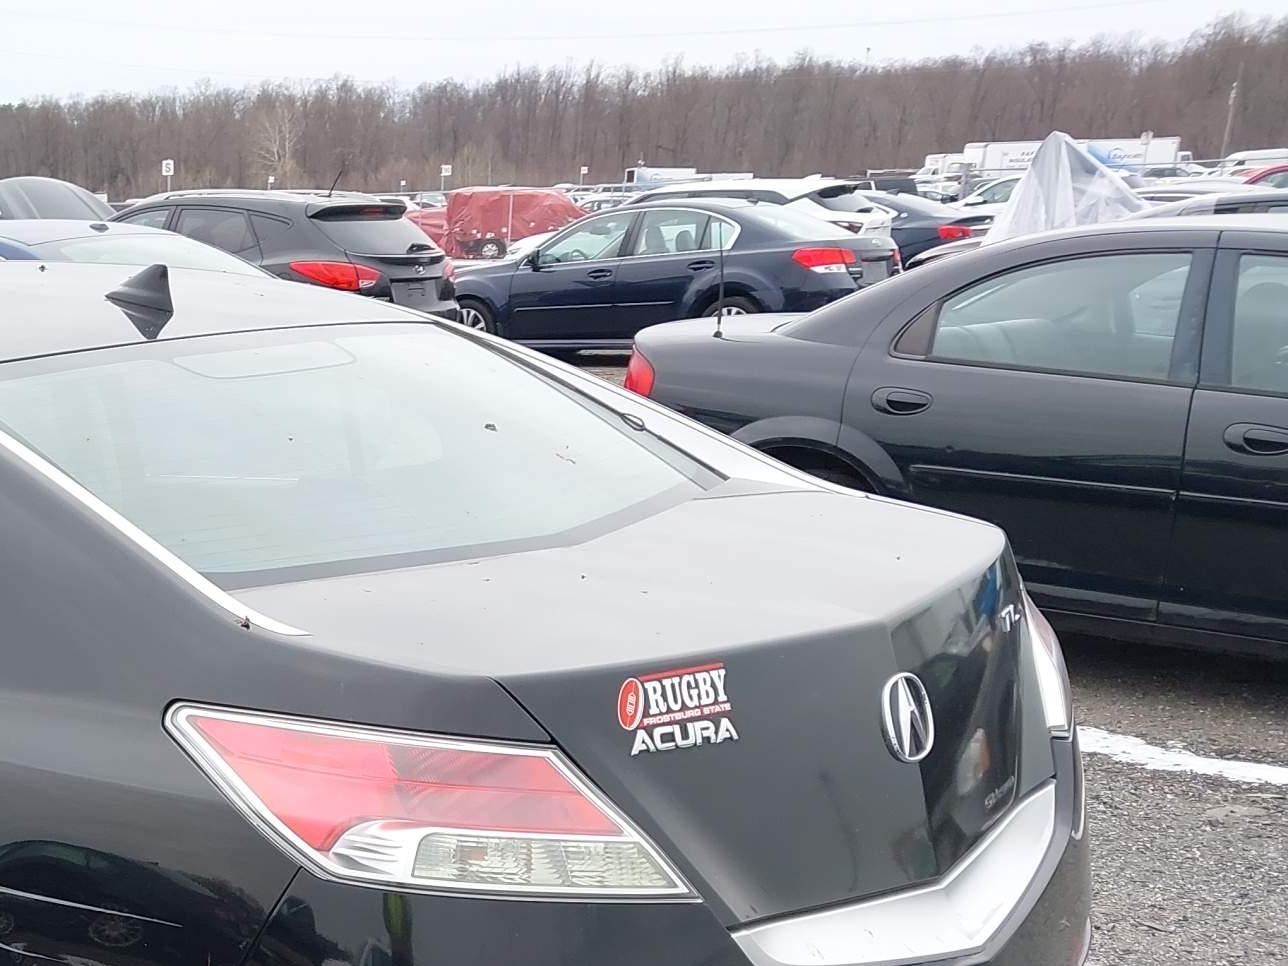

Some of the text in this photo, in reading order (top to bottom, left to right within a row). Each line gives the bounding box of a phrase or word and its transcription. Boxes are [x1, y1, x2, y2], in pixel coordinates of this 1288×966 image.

[643, 668, 728, 715] RUGBY
[642, 701, 732, 727] FROSTBURG STATE
[630, 717, 740, 757] ACURA
